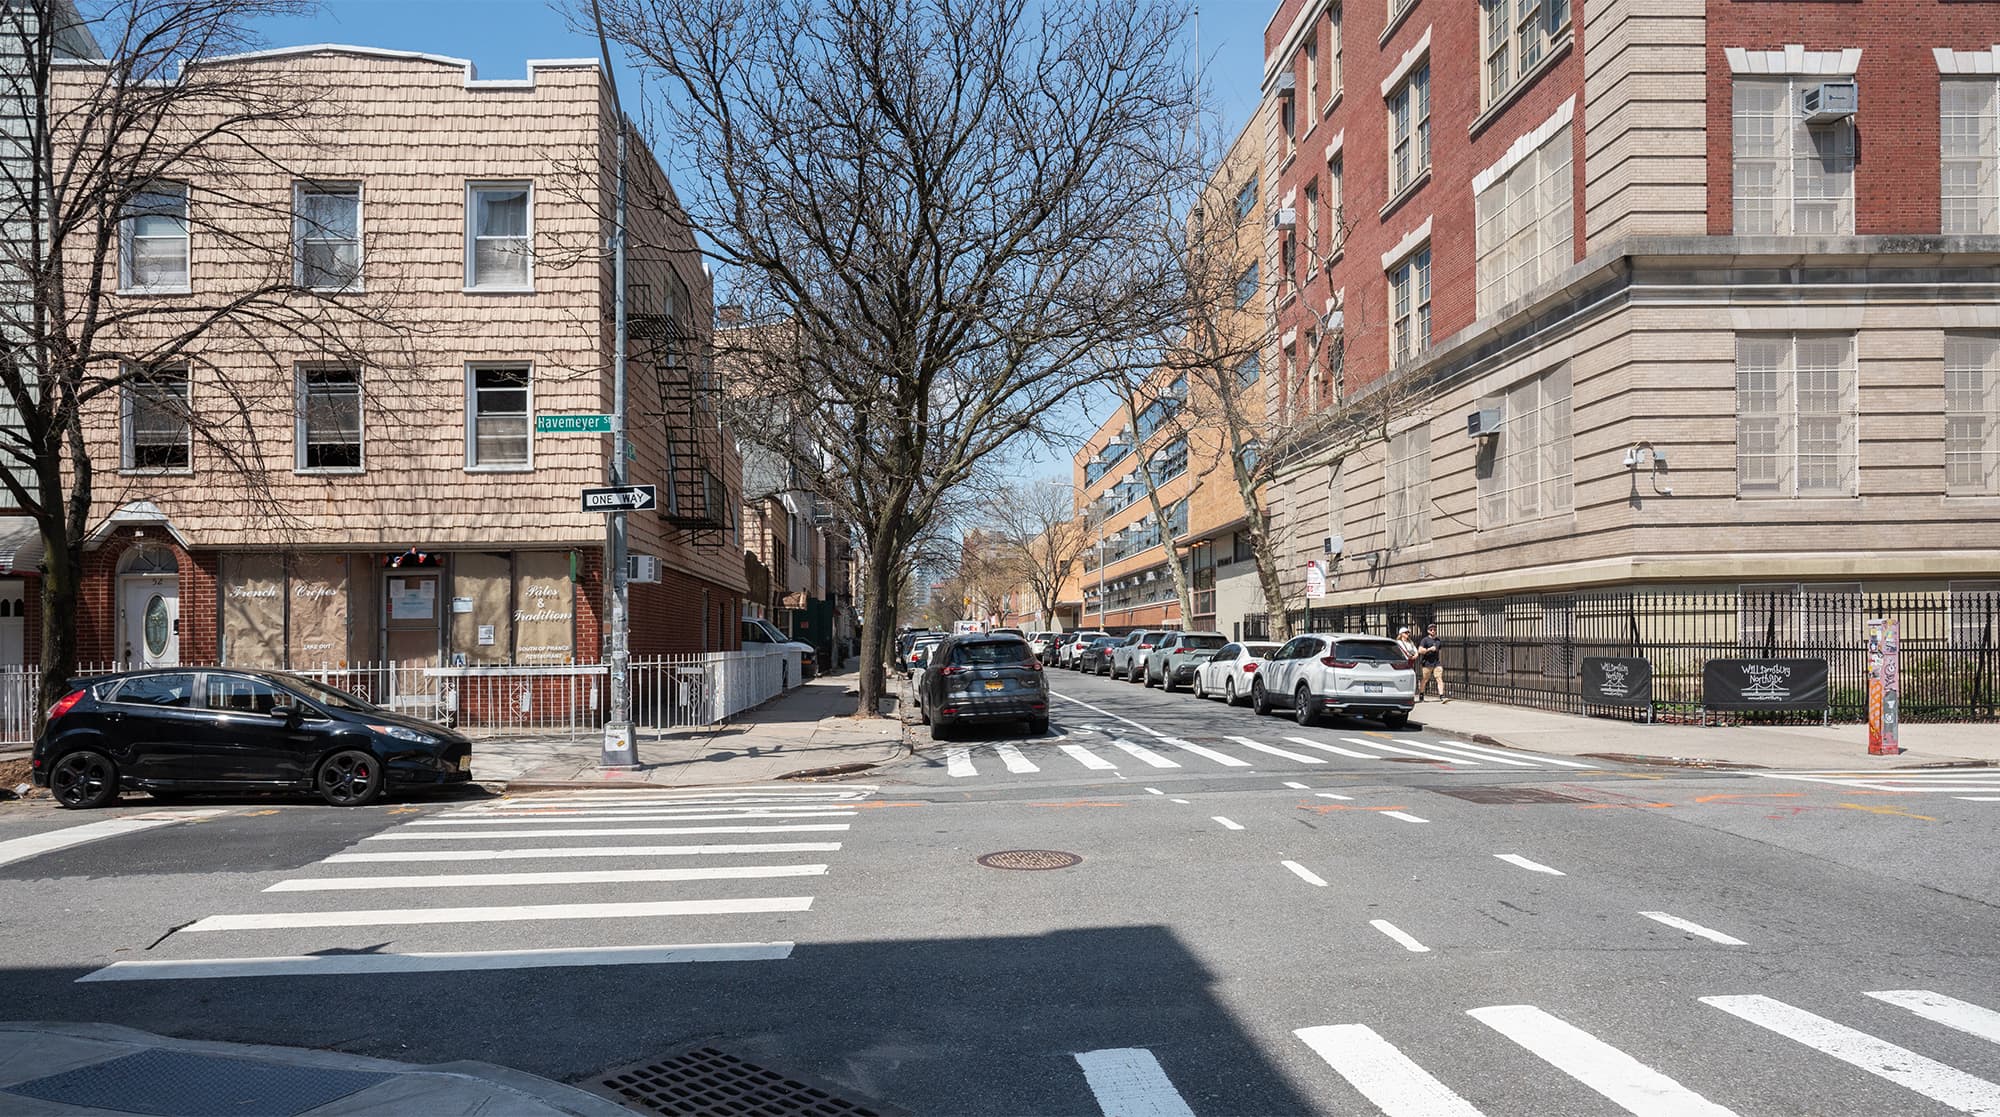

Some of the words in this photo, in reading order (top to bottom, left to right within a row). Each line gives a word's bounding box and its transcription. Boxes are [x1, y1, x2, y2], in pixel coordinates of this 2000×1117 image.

[538, 416, 600, 431] Havemeyer
[592, 495, 614, 505] ONE
[622, 494, 644, 504] WAY
[229, 585, 277, 598] French
[537, 597, 545, 608] &
[513, 609, 573, 622] Traditions
